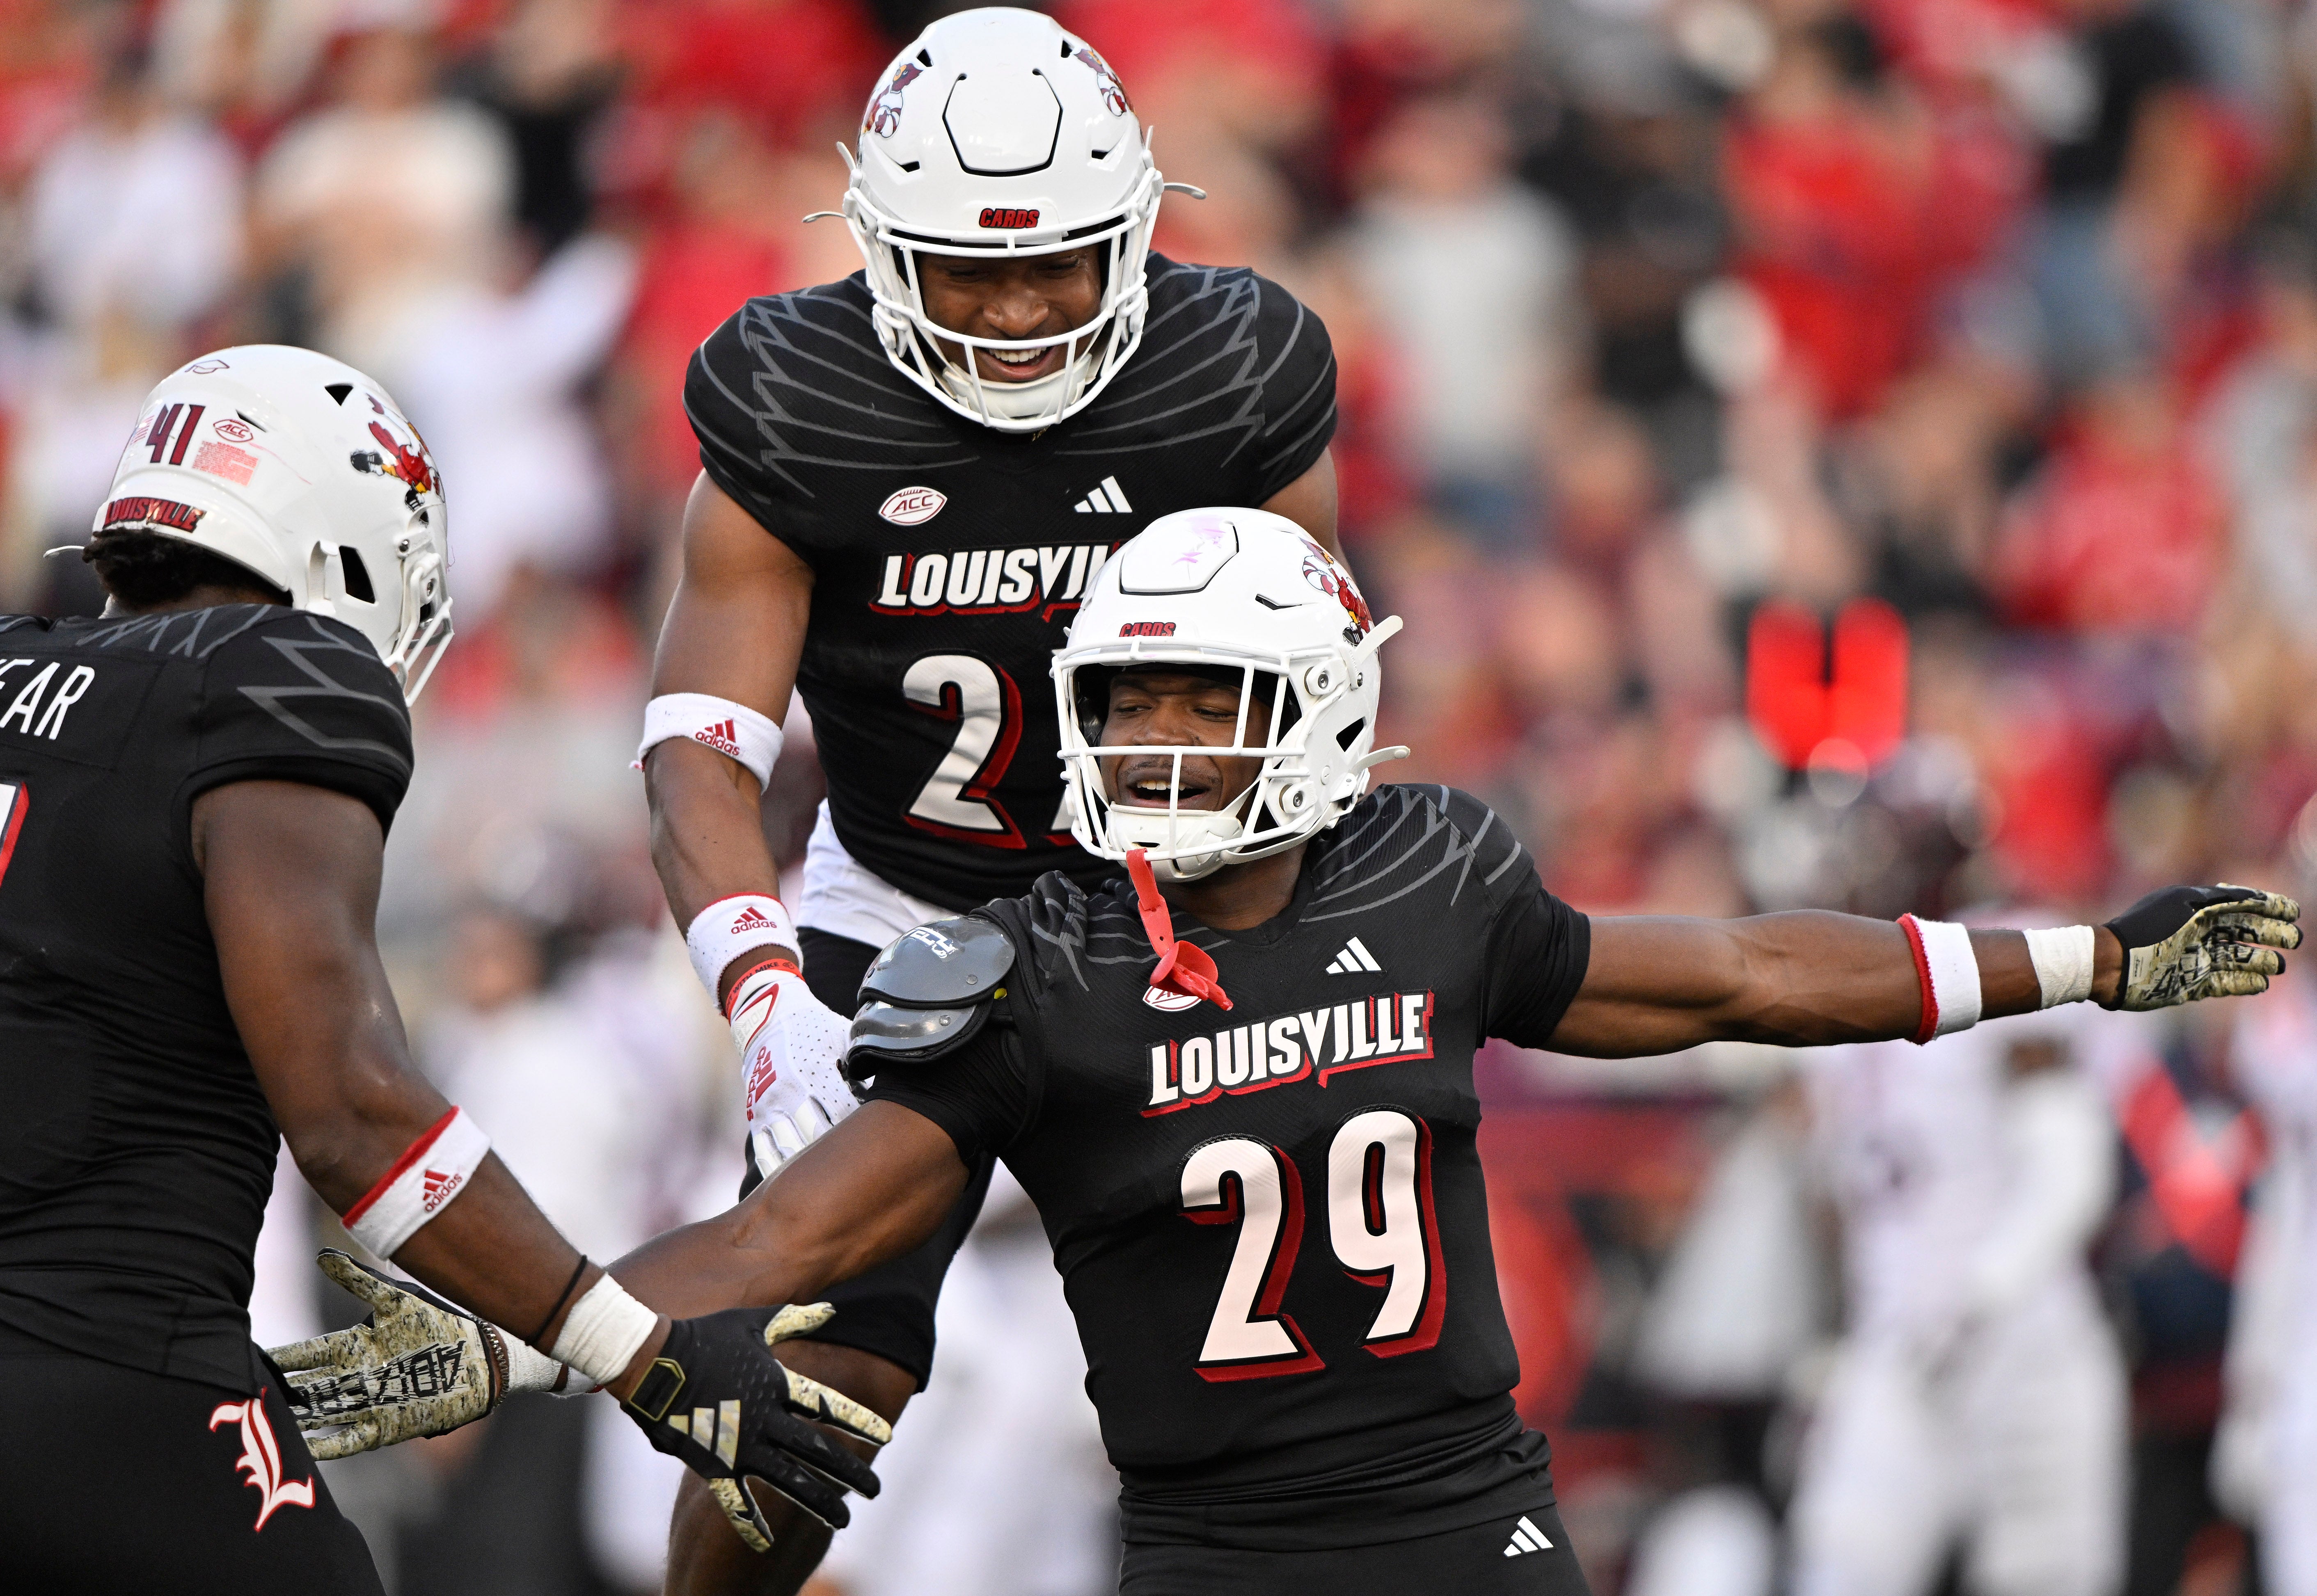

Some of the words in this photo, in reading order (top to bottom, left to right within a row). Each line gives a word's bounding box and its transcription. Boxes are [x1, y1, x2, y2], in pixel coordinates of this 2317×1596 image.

[979, 208, 1039, 228] CARDS
[146, 404, 206, 465] 41
[219, 424, 247, 437] ACC
[103, 497, 207, 533] LOUISVILLE
[891, 494, 934, 514] ACC
[1119, 622, 1176, 637] CARDS
[695, 732, 740, 756] adidas
[731, 920, 778, 934] adidas
[755, 961, 779, 974] MIKE
[1146, 992, 1427, 1108] LOUISVILLE
[746, 1045, 767, 1122] adidas
[425, 1173, 462, 1212] adidas
[1179, 1109, 1436, 1366] 29
[209, 1386, 316, 1533] L
